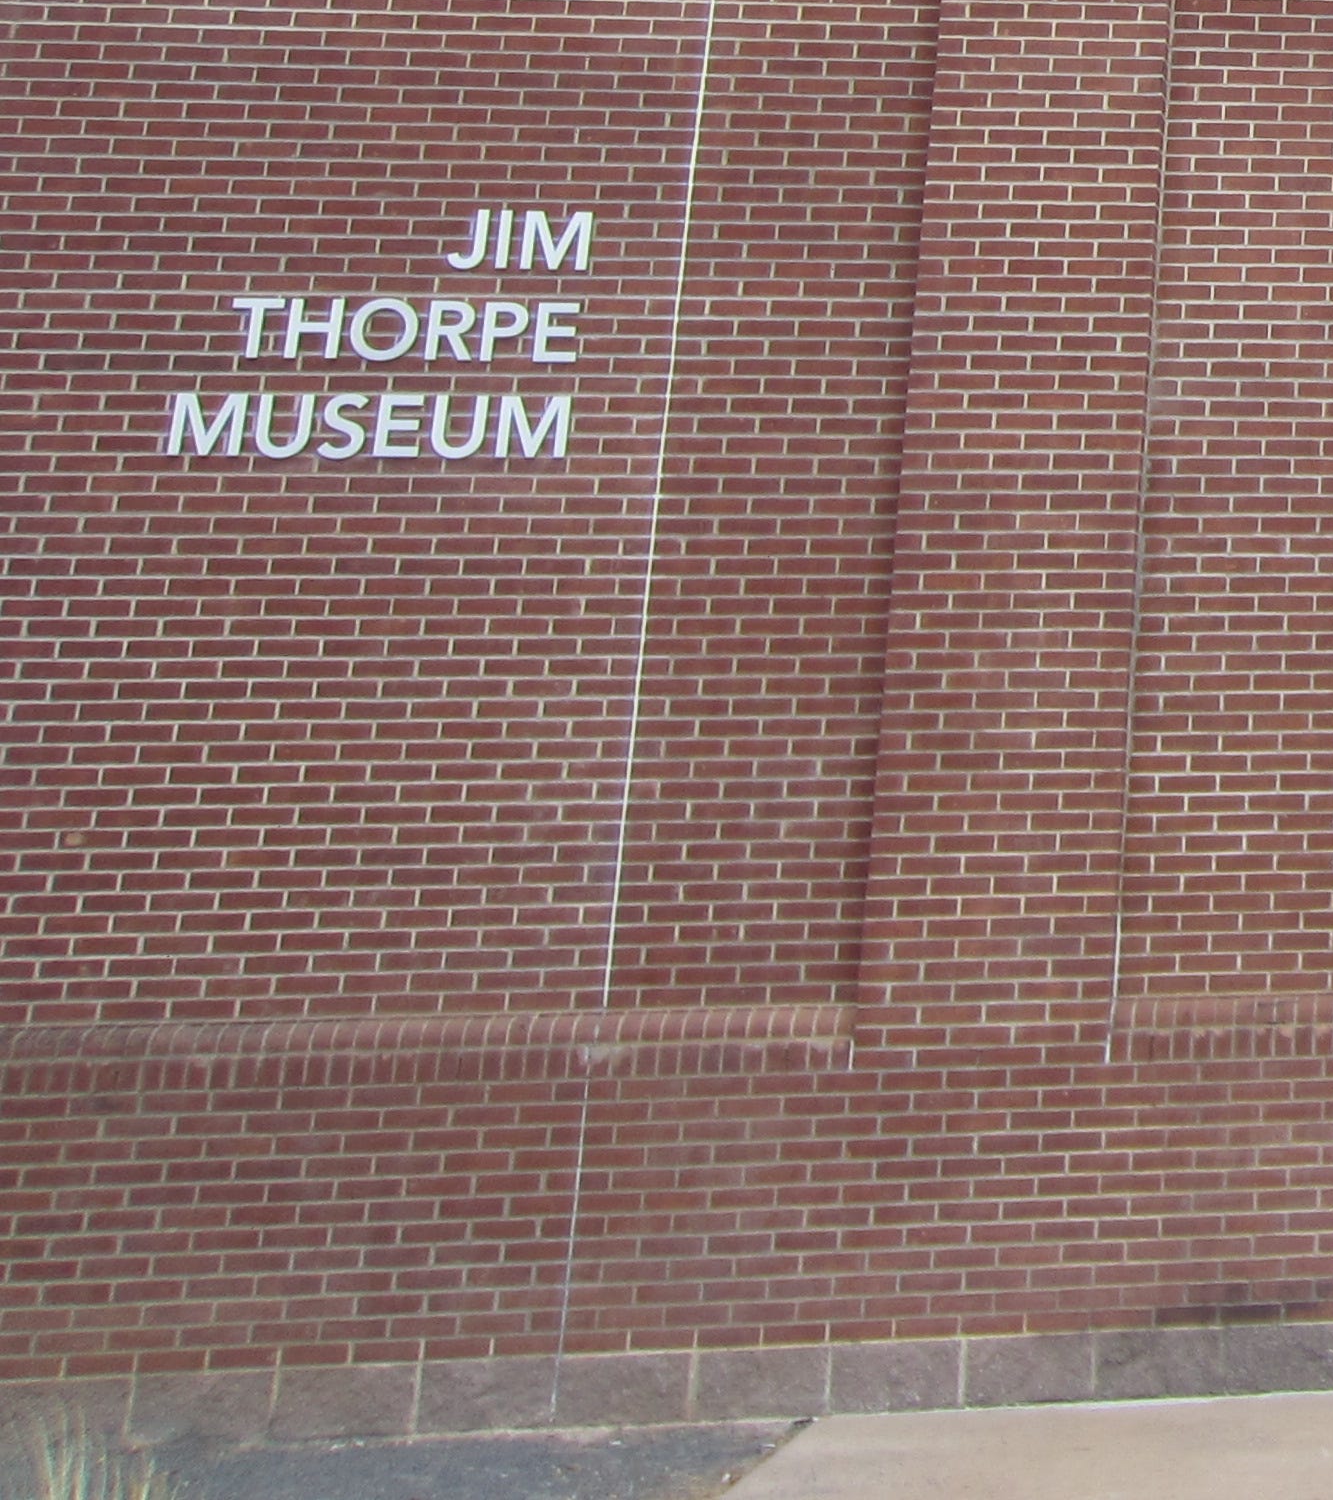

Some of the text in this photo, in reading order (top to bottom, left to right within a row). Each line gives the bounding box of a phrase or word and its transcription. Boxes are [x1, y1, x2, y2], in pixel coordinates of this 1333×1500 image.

[446, 209, 594, 271] JIM
[232, 297, 581, 363] THORPE
[166, 392, 572, 460] MUSEUM
